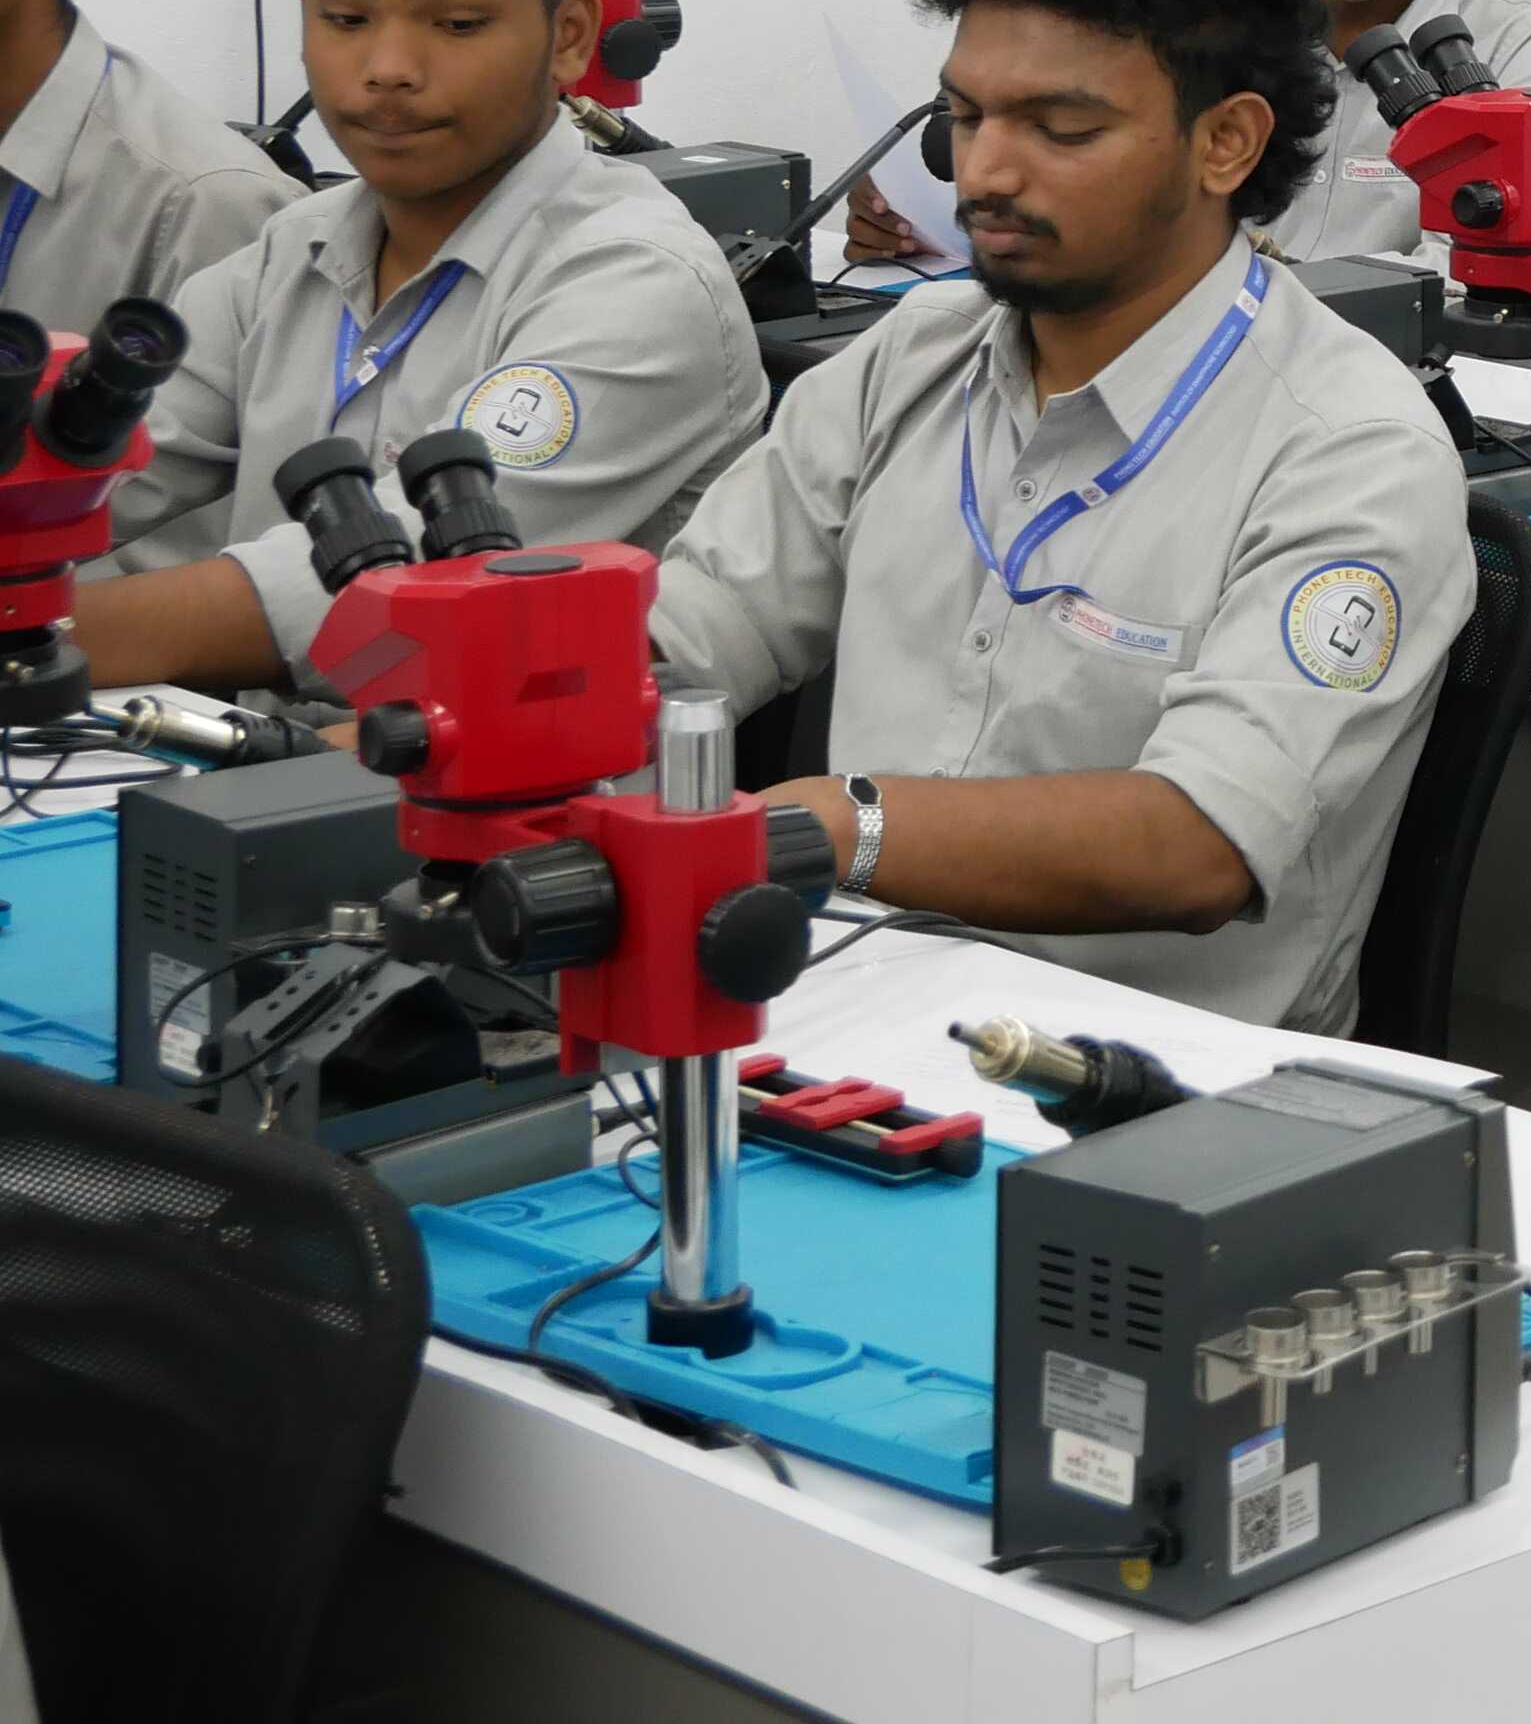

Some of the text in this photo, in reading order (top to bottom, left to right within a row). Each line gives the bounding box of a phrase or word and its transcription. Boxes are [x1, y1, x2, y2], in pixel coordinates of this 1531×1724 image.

[1293, 575, 1330, 614] PHONE
[1334, 570, 1377, 585] TECH
[1116, 627, 1168, 647] EDUCATION
[1291, 629, 1375, 689] INTERNATIONAL
